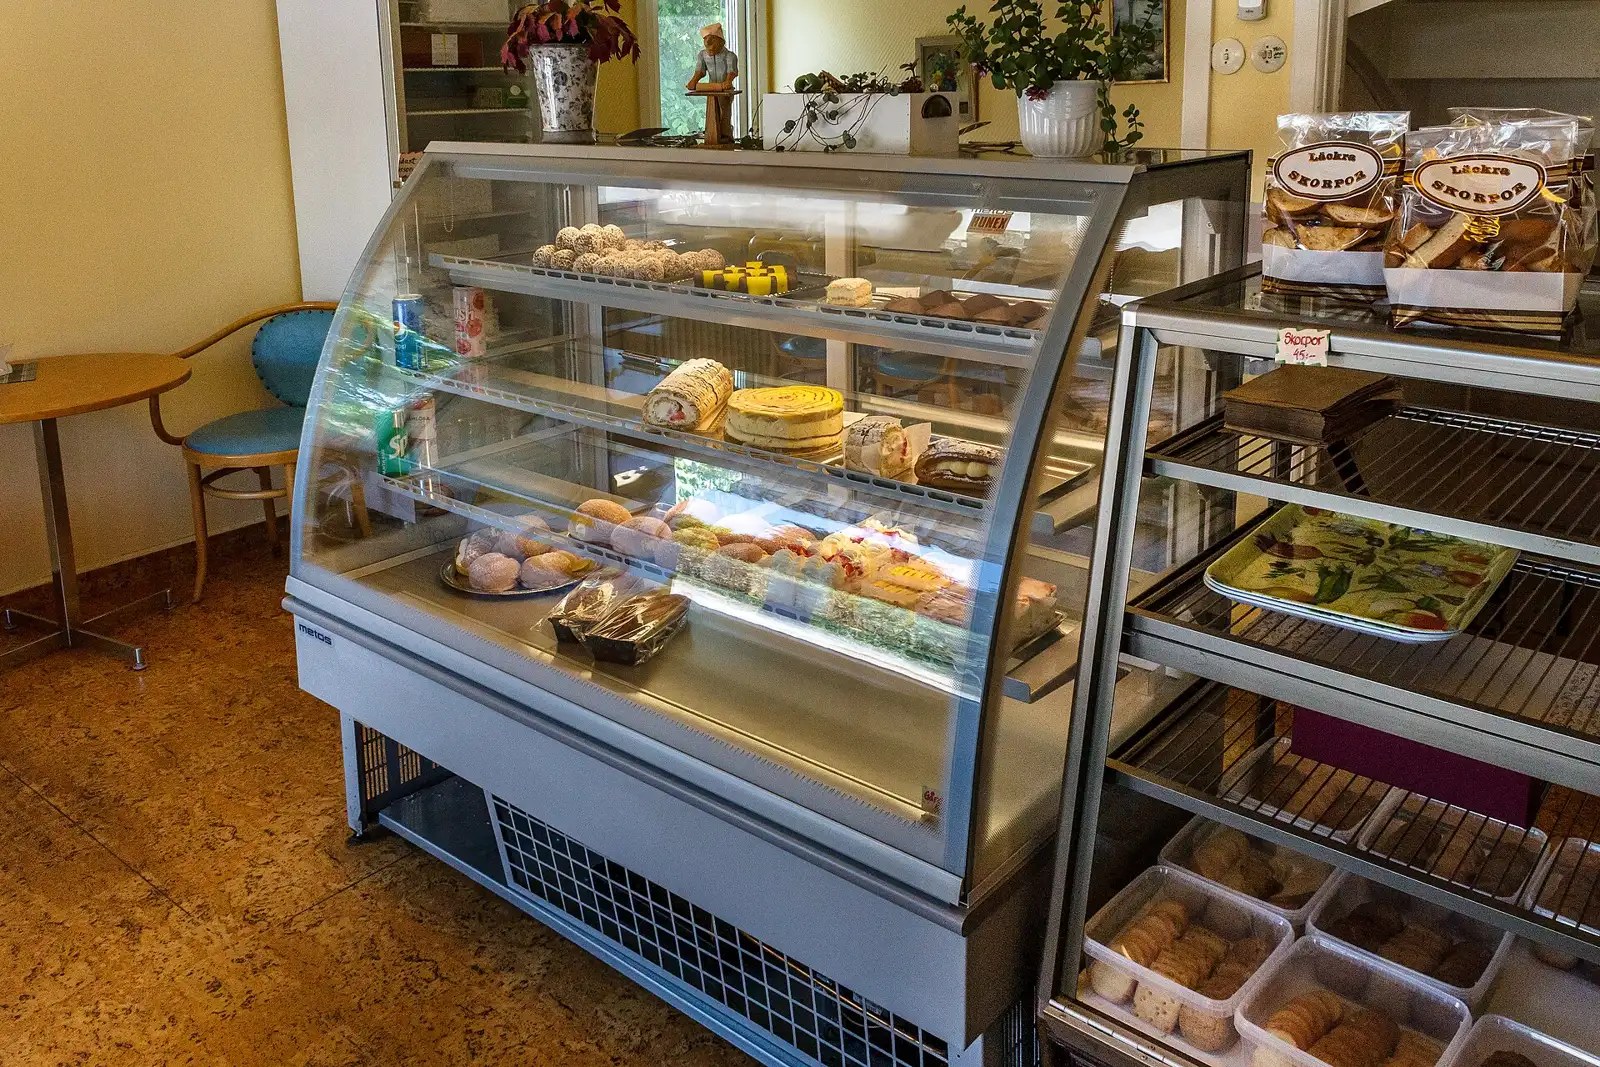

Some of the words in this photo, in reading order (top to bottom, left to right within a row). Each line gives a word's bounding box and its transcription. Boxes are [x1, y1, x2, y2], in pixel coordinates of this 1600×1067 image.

[1288, 170, 1367, 189] SKORPOR
[1431, 180, 1528, 203] SKORPOR
[970, 216, 1009, 229] RUNEX
[1284, 332, 1325, 347] Skorpor
[299, 623, 332, 645] metos
